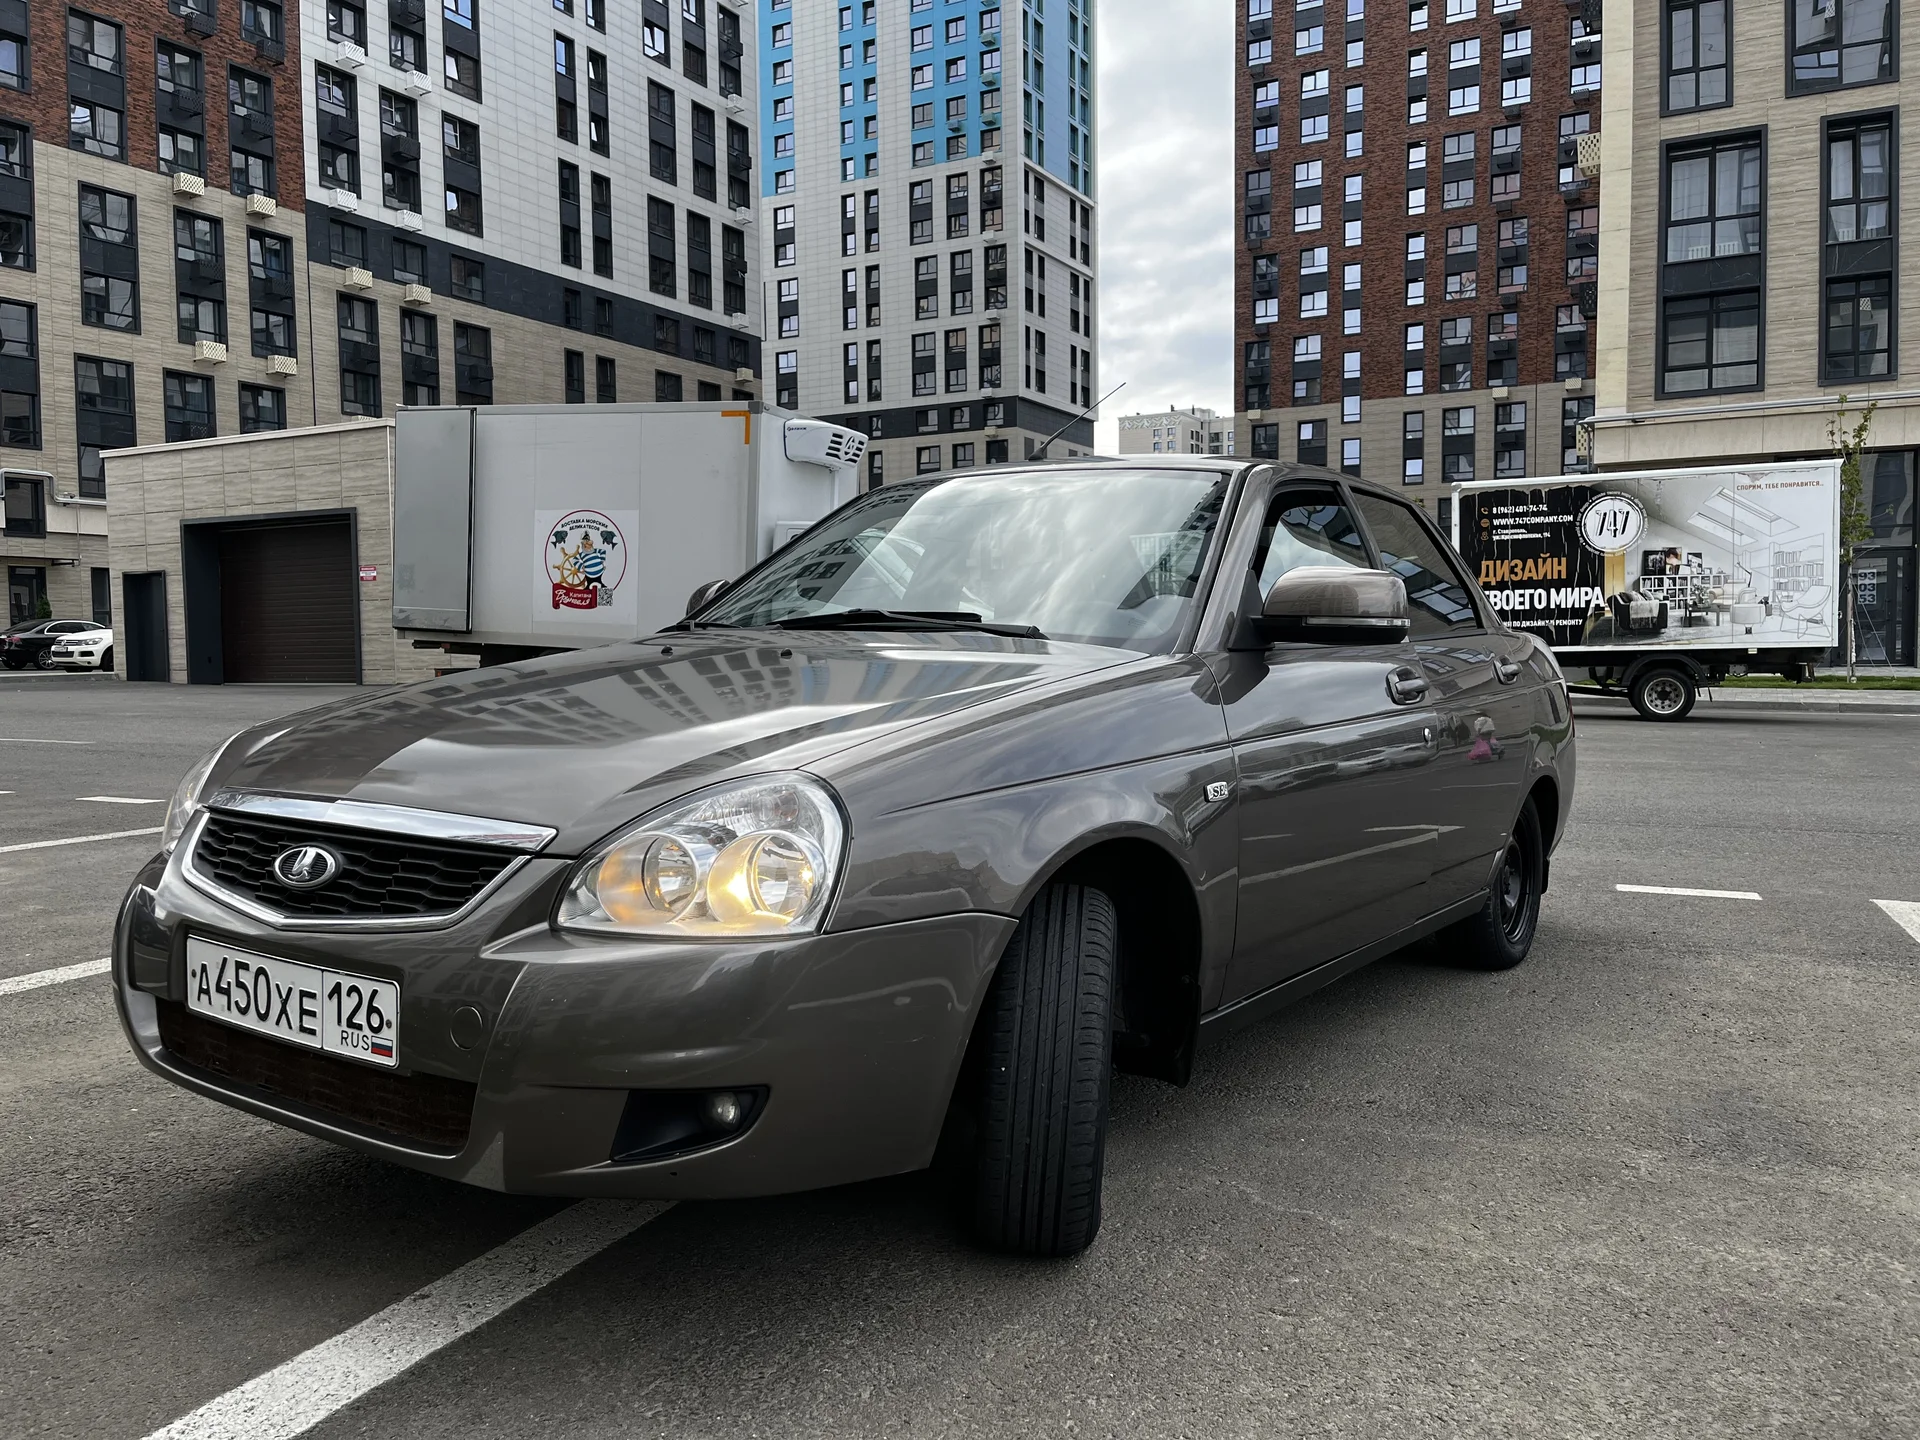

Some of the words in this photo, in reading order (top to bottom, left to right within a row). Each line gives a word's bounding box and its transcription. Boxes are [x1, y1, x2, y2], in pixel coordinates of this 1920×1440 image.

[1736, 483, 1764, 491] СПОРИМ,
[1765, 482, 1779, 490] ТЕБЕ
[1492, 506, 1497, 514] 8
[1498, 506, 1514, 514] (962)
[561, 518, 585, 529] ДОСТАВКА
[585, 518, 609, 529] МОРСКИХ
[1492, 514, 1574, 526] WWW.747COMPANY.COM
[1595, 508, 1630, 538] 747
[569, 524, 600, 532] ДЕЛИКАТЕСОВ
[1478, 552, 1567, 586] ДИЗАЙН
[1858, 571, 1876, 581] 93
[1858, 582, 1876, 592] 03
[555, 589, 591, 605] Врунгеля
[1550, 586, 1605, 609] МИРА
[1858, 593, 1876, 603] 53
[1556, 618, 1583, 626] РЕМОНТУ
[1212, 785, 1225, 797] SE
[197, 955, 318, 1036] А450ХЕ
[327, 980, 385, 1034] 126
[340, 1029, 370, 1051] RUS
